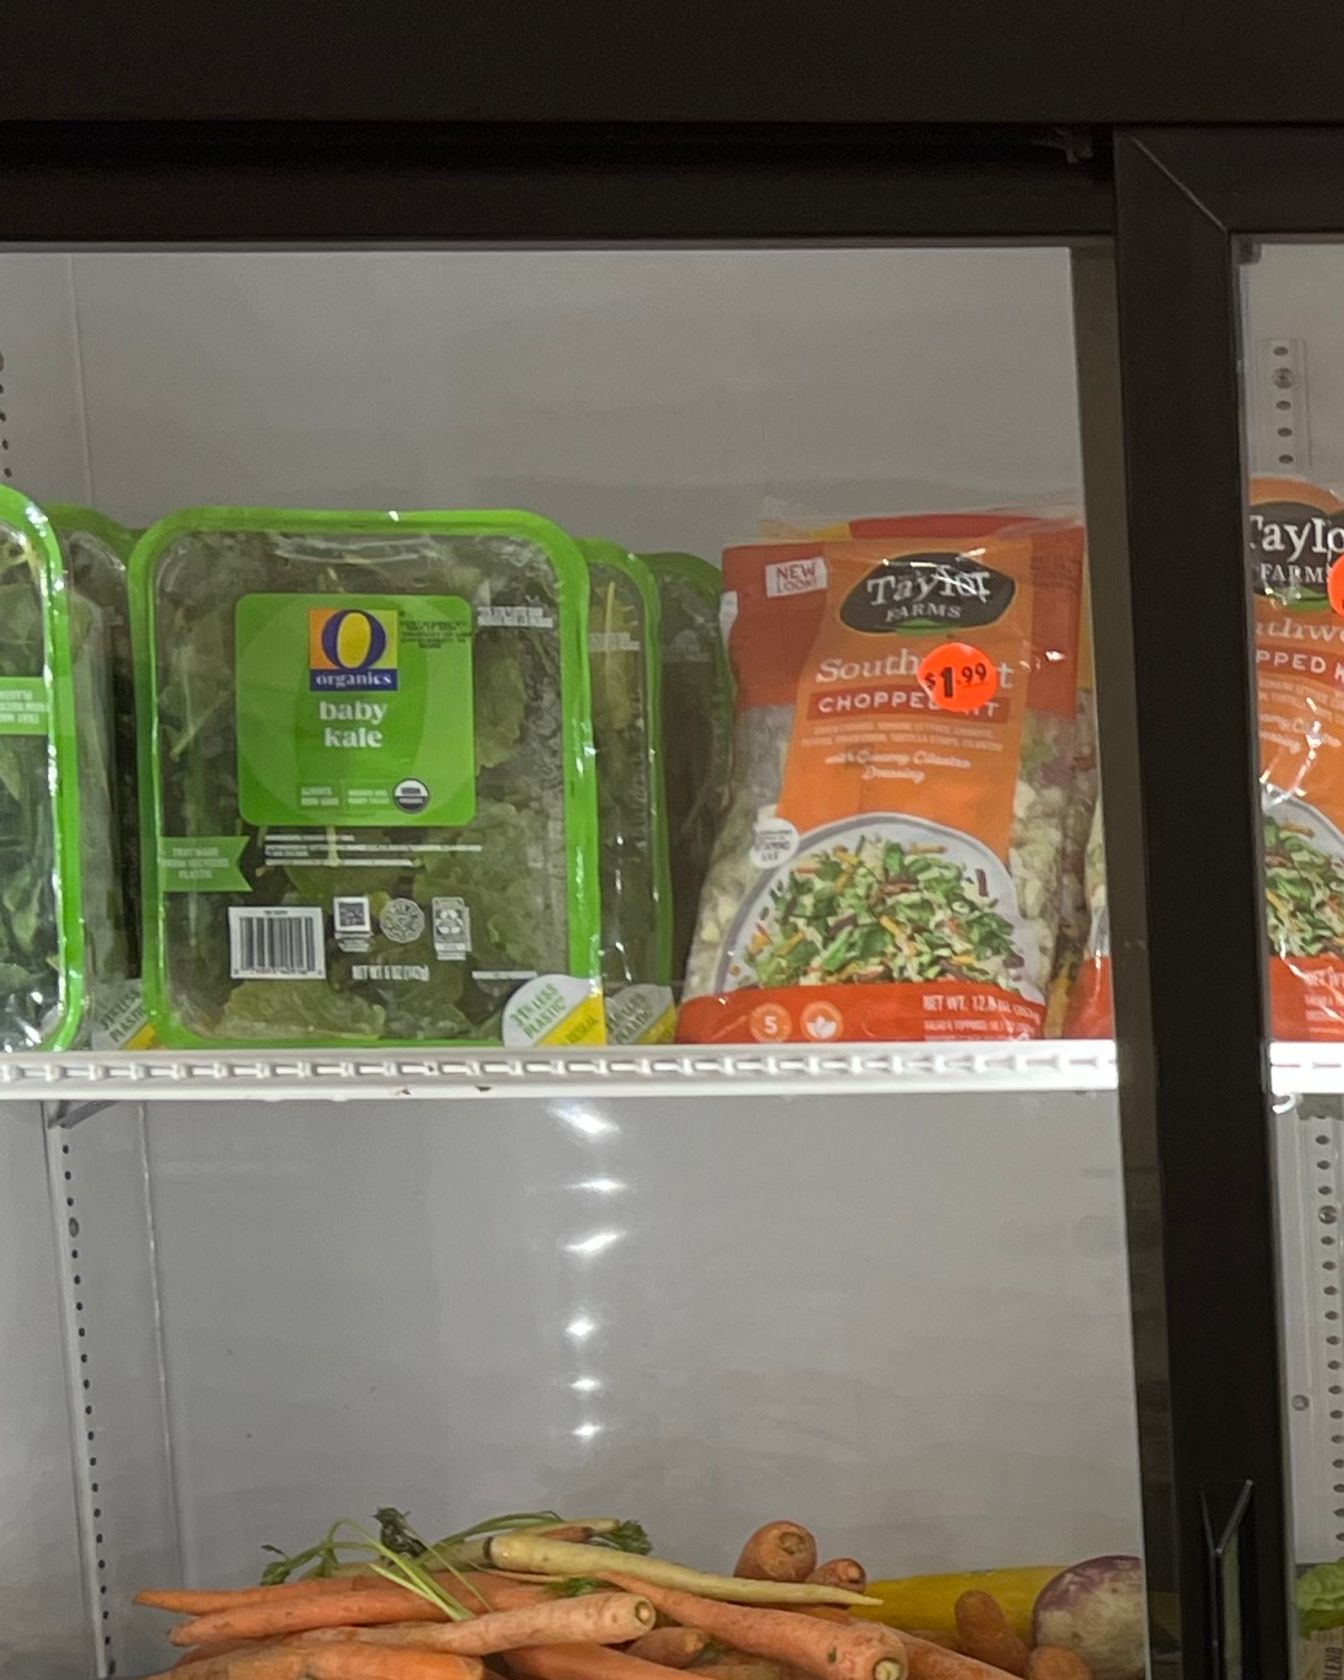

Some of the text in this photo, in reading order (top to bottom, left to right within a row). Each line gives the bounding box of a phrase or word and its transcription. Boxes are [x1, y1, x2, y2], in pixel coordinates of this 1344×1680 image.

[777, 562, 816, 580] NEW
[1259, 563, 1330, 585] FARM
[867, 564, 991, 606] Taylor
[885, 604, 962, 623] FARMS
[815, 648, 1015, 688] Southt
[1256, 648, 1327, 674] PPED
[316, 672, 392, 688] organics
[924, 661, 988, 699] $1.99
[319, 701, 387, 724] baby
[324, 727, 383, 748] kale
[763, 1015, 779, 1034] 5
